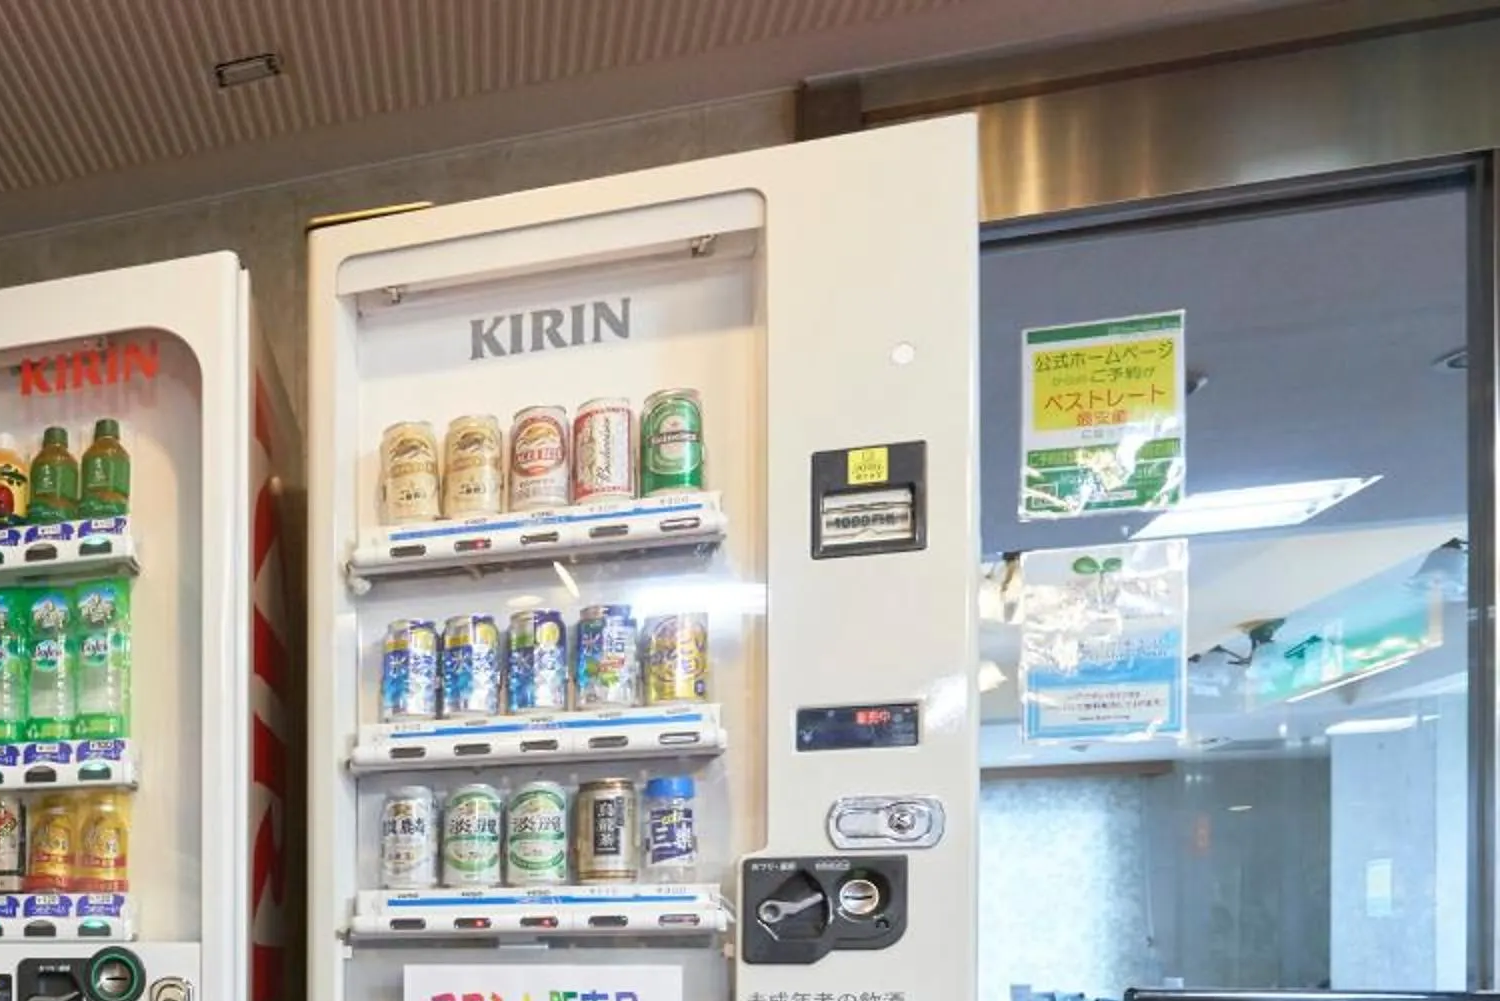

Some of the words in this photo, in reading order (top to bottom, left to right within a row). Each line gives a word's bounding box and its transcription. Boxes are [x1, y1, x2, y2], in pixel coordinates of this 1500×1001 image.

[470, 297, 632, 361] KIRIN
[19, 341, 160, 396] KIRIN
[1034, 338, 1174, 373] 公式ホームページ
[1043, 383, 1166, 412] ベストレート
